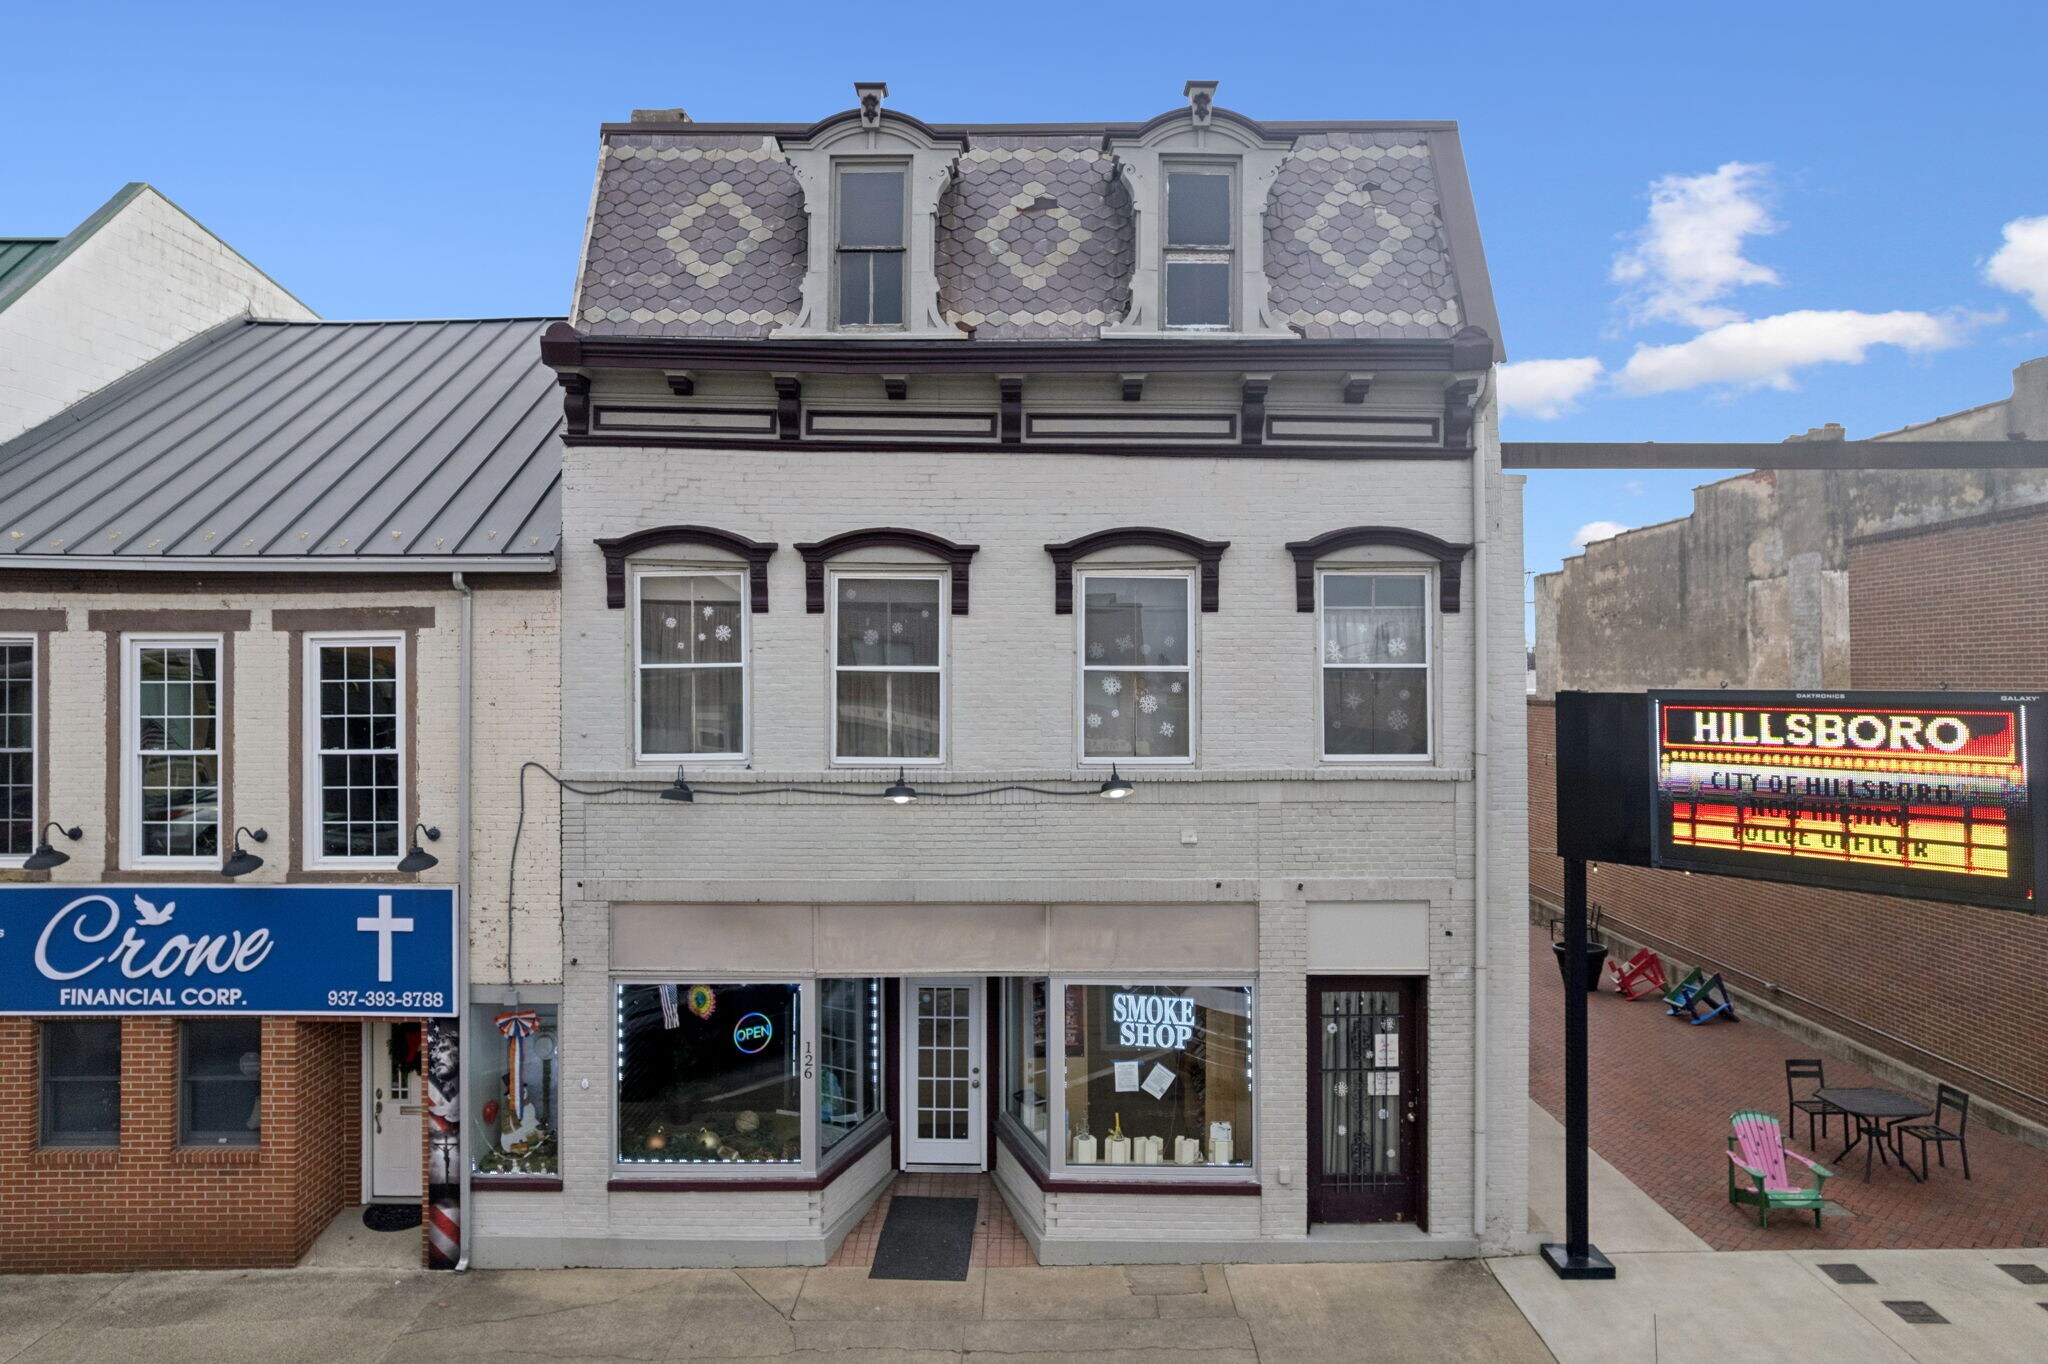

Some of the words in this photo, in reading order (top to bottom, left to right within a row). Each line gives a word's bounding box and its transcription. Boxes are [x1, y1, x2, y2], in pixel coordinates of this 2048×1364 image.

[1693, 711, 1970, 753] HILLSBORO
[1711, 771, 1761, 792] CITY
[1769, 775, 1798, 795] OF
[1806, 776, 1953, 804] HILLSBORO
[34, 894, 274, 981] Crowe
[60, 988, 175, 1005] FINANCIAL
[181, 988, 247, 1006] CORP.
[327, 990, 444, 1008] 937-393-8788
[1112, 993, 1195, 1027] SMOKE
[736, 1024, 770, 1042] OPEN
[1120, 1022, 1193, 1050] SHOP
[804, 1041, 813, 1079] 126
